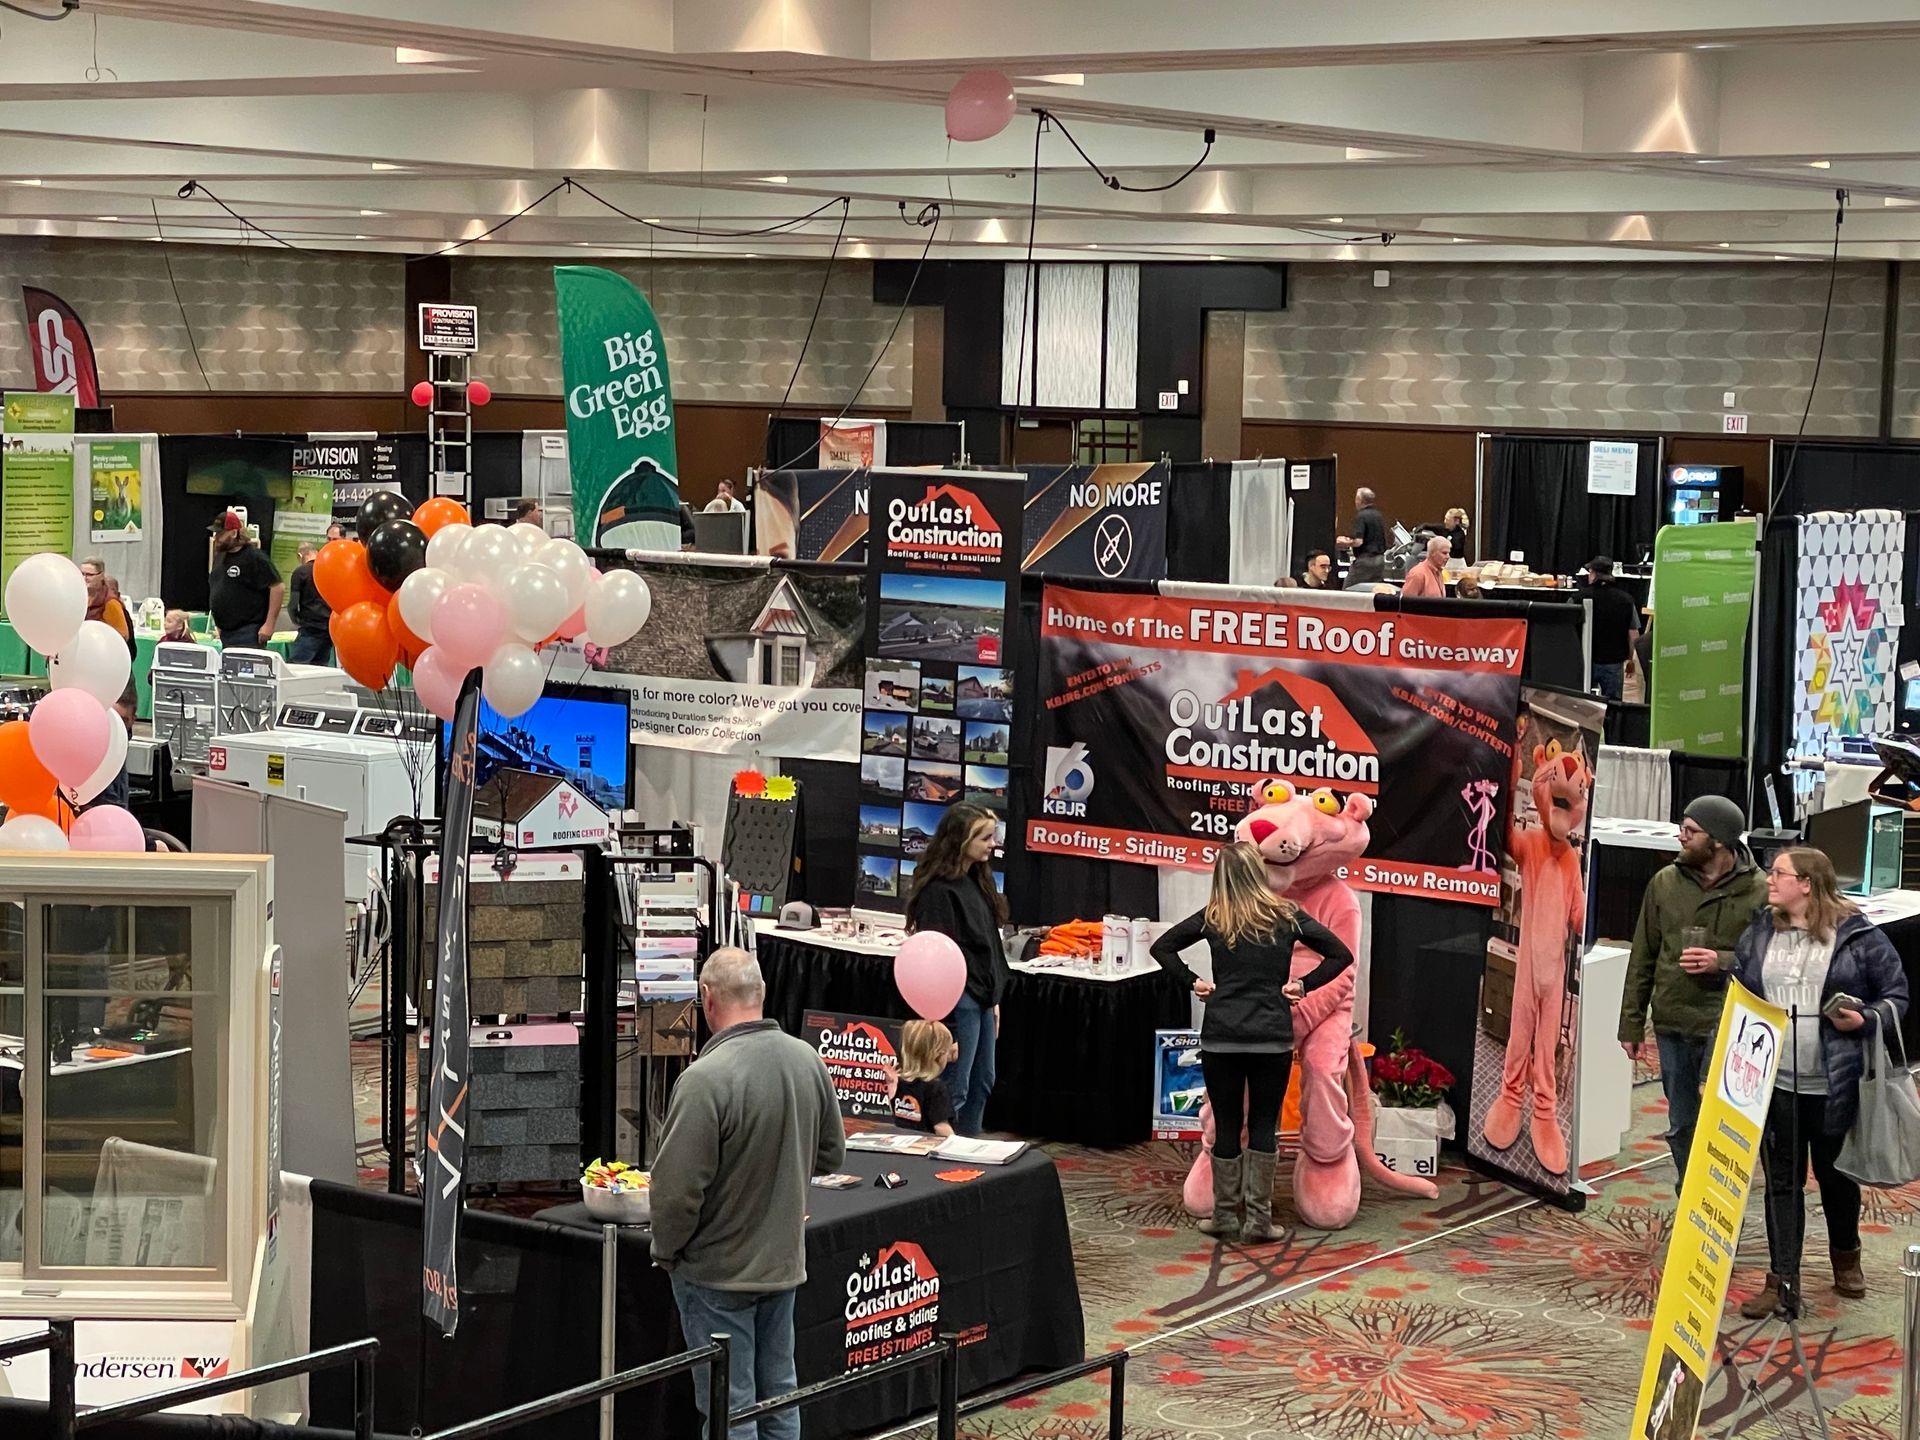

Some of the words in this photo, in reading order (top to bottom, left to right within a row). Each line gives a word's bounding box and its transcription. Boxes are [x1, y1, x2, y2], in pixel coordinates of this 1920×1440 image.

[431, 308, 473, 319] PROVISION
[603, 329, 657, 373] Big
[569, 366, 664, 418] Green
[1161, 394, 1176, 407] EXIT
[611, 393, 671, 440] Egg
[1726, 416, 1744, 431] EXIT
[1687, 472, 1717, 483] pepsi
[1069, 483, 1100, 508] NO
[1105, 481, 1162, 507] MORE
[888, 498, 973, 525] OutLast
[887, 520, 1003, 548] Construction
[887, 549, 922, 560] Roofing,
[924, 551, 949, 561] Siding
[951, 552, 958, 560] &
[960, 554, 1001, 563] Insulation
[1047, 606, 1107, 634] Home
[1112, 617, 1136, 637] of
[1139, 618, 1184, 640] The
[1189, 607, 1289, 649] FREE
[1297, 615, 1395, 657] Roof
[1399, 638, 1520, 669] Giveaway
[643, 687, 659, 701] for
[663, 690, 695, 703] more
[698, 692, 738, 707] color?
[741, 694, 776, 710] We've
[778, 700, 798, 713] got
[801, 702, 827, 714] you
[631, 708, 670, 720] ntroducing
[672, 711, 706, 722] Duration
[1169, 688, 1324, 738] OutLast
[1458, 701, 1474, 718] TO
[1475, 711, 1499, 731] WIN
[576, 735, 596, 744] Mobil
[631, 718, 675, 734] Designer
[677, 724, 709, 737] Colors
[712, 727, 761, 742] Collection
[210, 752, 226, 766] 25
[1165, 726, 1380, 783] Construction
[1166, 776, 1226, 796] Roofing,
[1043, 799, 1087, 818] KBJR
[1209, 797, 1245, 812] FREE
[553, 830, 581, 840] ROOFING
[581, 828, 605, 838] CENTER
[1032, 826, 1111, 855] Roofing
[1125, 837, 1188, 865] Siding
[1364, 865, 1419, 888] Snow
[820, 1028, 878, 1050] OutLast
[818, 1043, 898, 1066] Construction
[827, 1065, 853, 1079] ofing
[854, 1068, 863, 1077] &
[840, 1079, 890, 1093] INSPECTIO
[846, 1257, 916, 1297] OutLast
[844, 1275, 940, 1321] Construction
[845, 1320, 893, 1348] Roofing
[895, 1316, 906, 1332] &
[909, 1305, 939, 1329] Siding
[848, 1345, 880, 1367] FREE
[881, 1326, 933, 1360] ESTIMATES
[74, 1356, 174, 1379] ndersen
